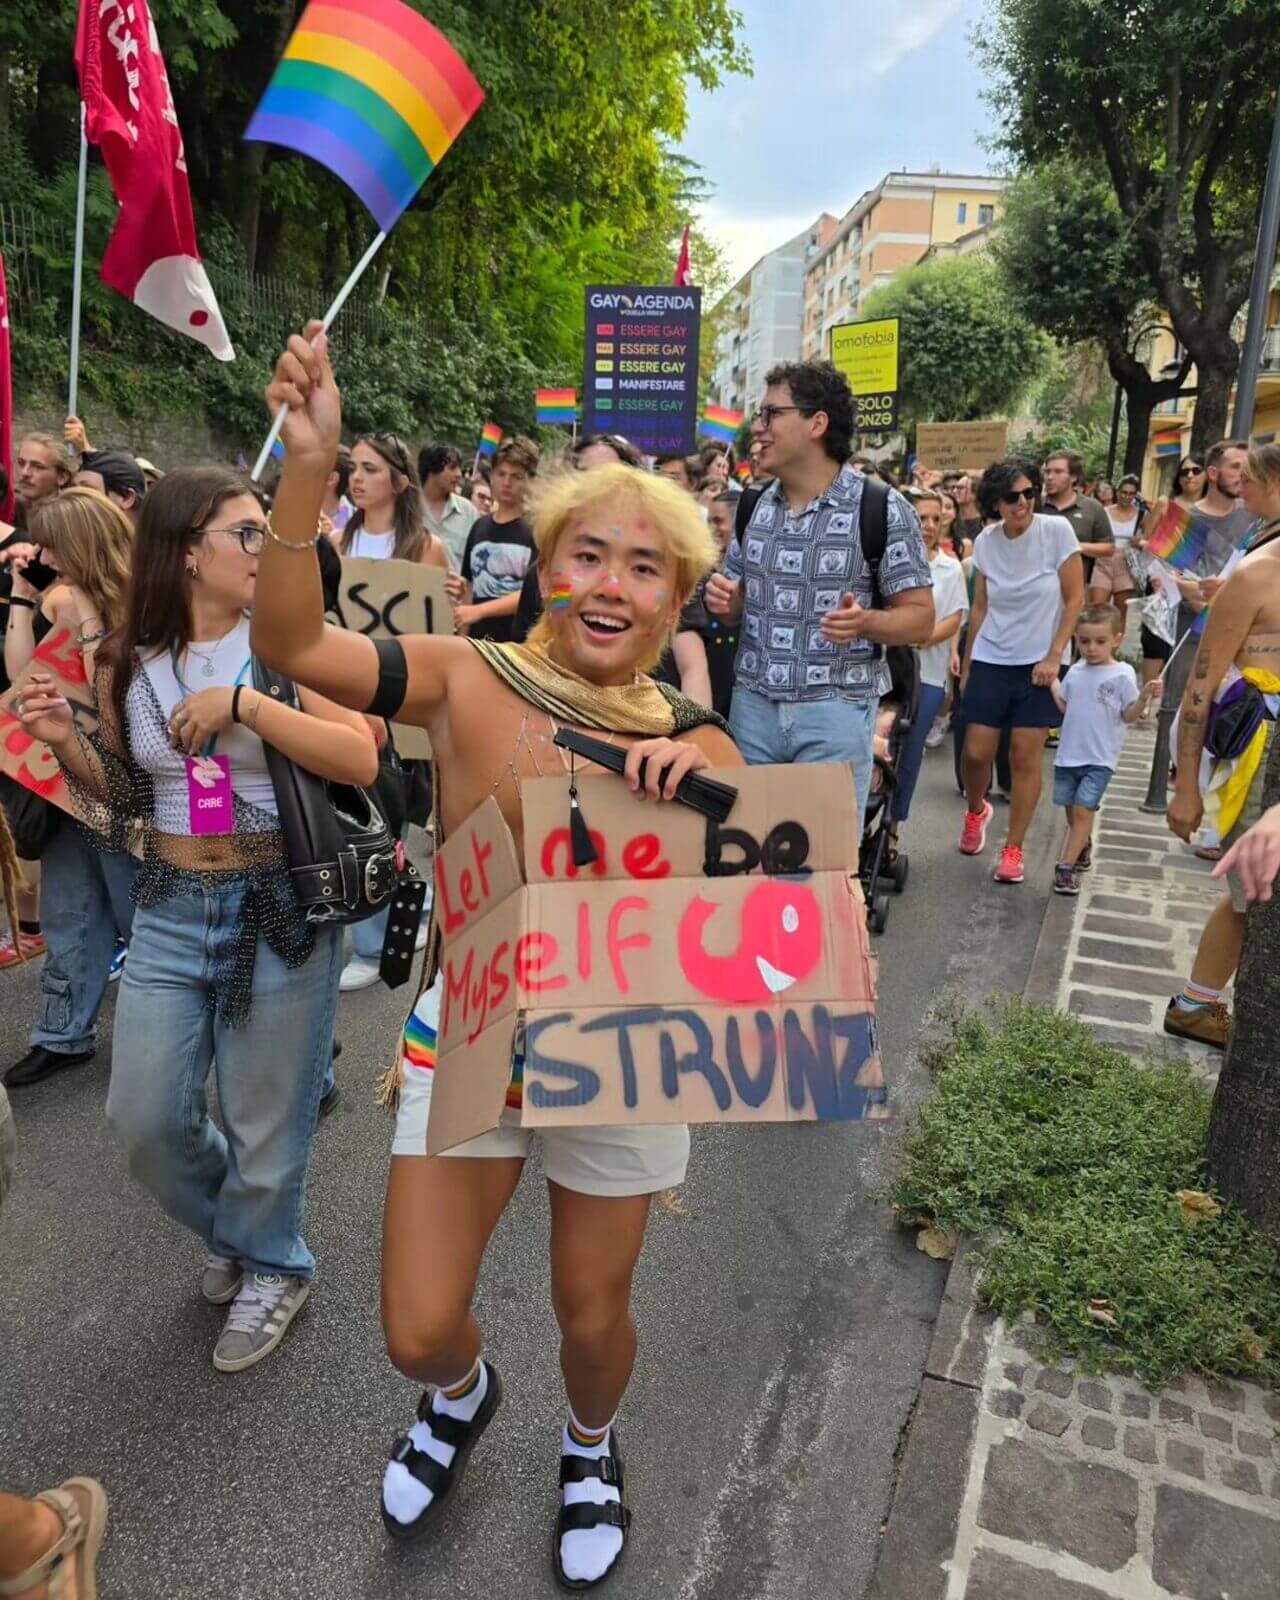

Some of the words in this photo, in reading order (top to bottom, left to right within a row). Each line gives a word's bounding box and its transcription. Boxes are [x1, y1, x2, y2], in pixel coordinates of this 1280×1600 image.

[590, 293, 621, 308] GAY
[633, 295, 695, 310] AGENDA
[620, 324, 660, 337] ESSERE
[662, 327, 687, 337] GAY
[834, 330, 895, 350] omofobia
[619, 342, 660, 355] ESSERE
[661, 345, 687, 356] GAY
[618, 360, 659, 373] ESSERE
[660, 361, 686, 374] GAY
[619, 379, 686, 391] MANIFESTARE
[618, 400, 657, 411] ESSERE
[659, 401, 684, 412] GAY
[857, 395, 893, 411] SOLO
[197, 796, 224, 809] CARE
[434, 832, 493, 936] Let
[540, 827, 672, 881] me
[702, 819, 813, 878] be
[442, 896, 652, 1046] Myself
